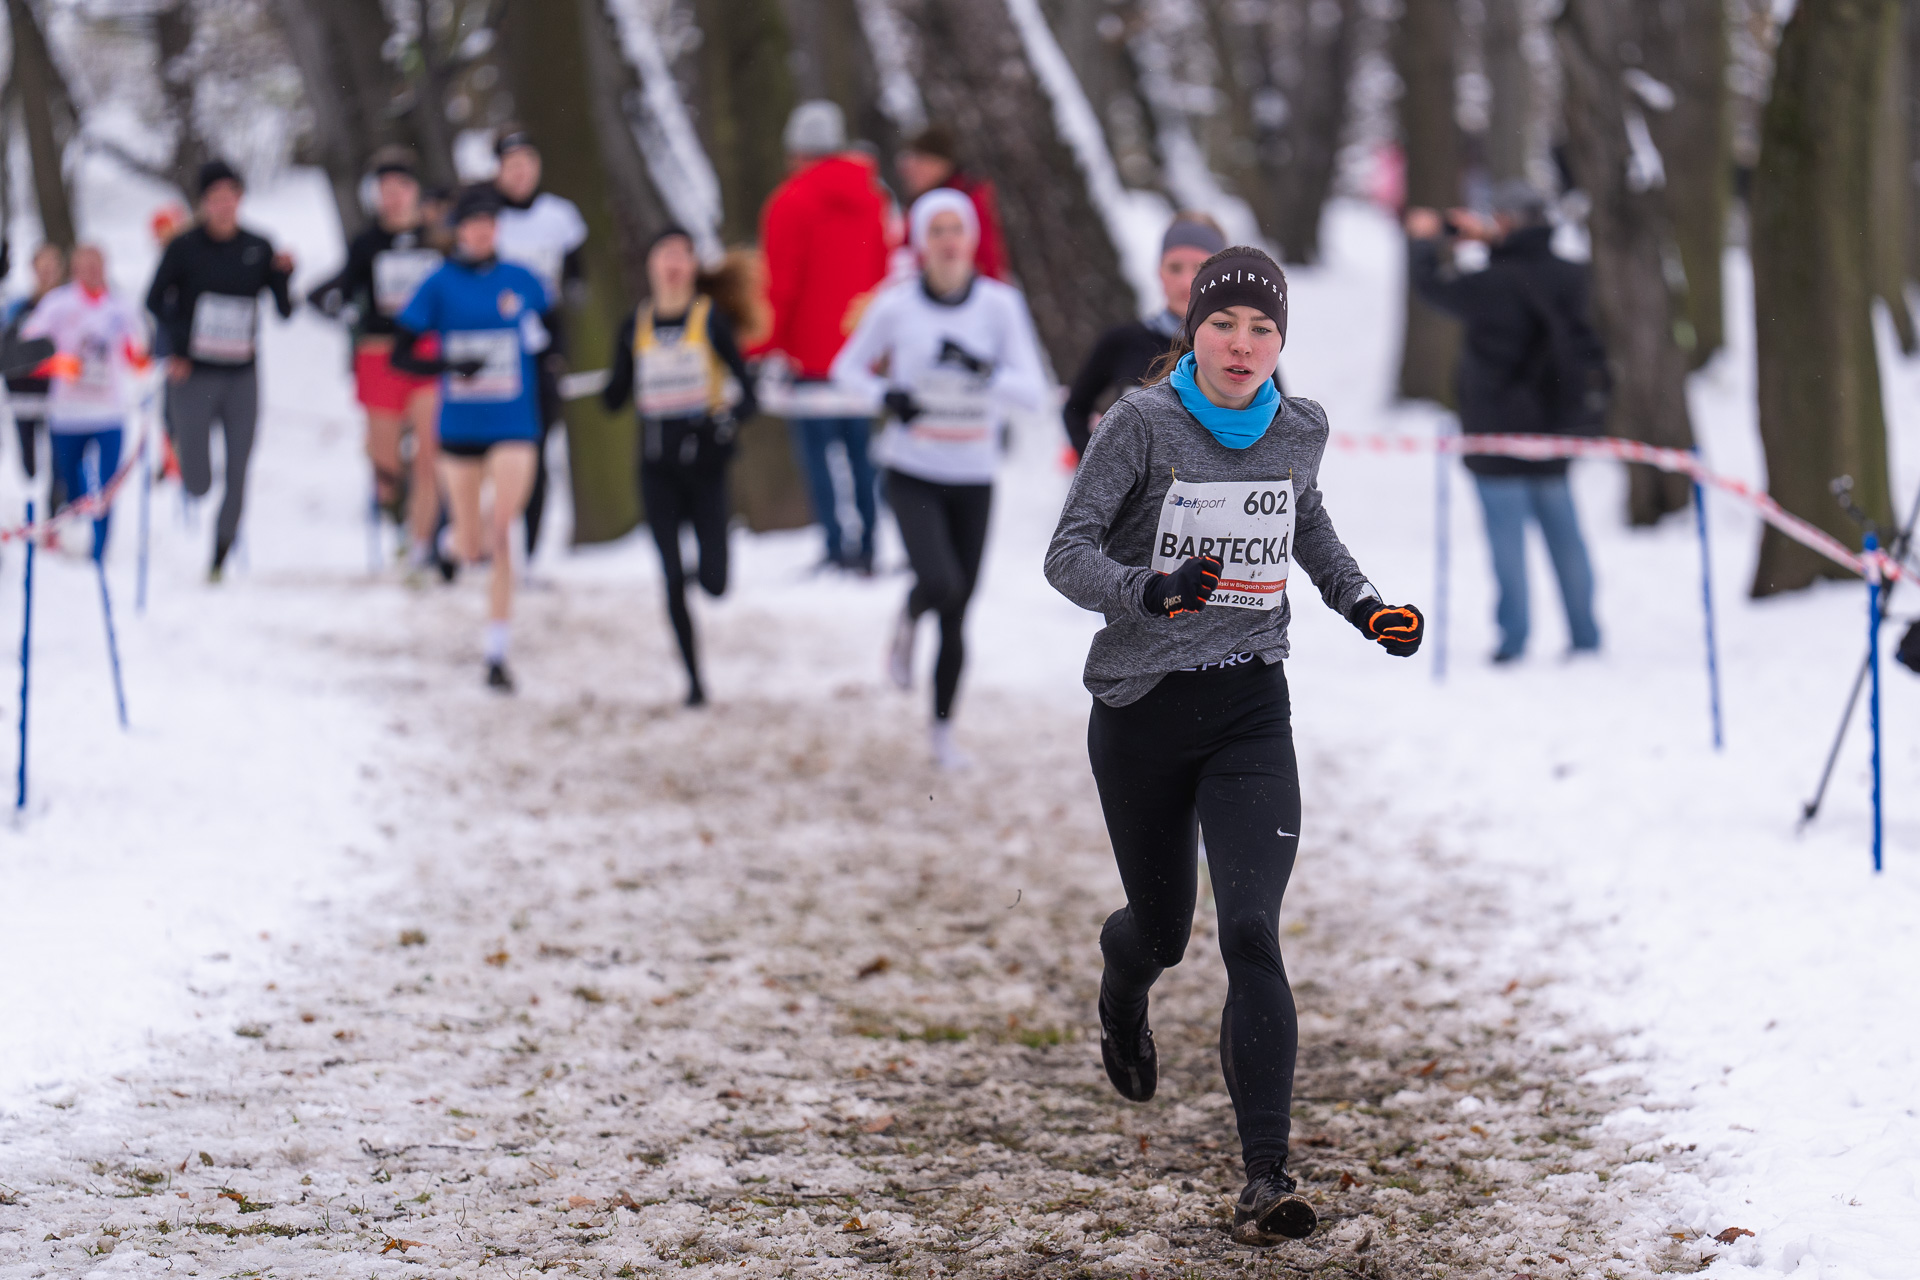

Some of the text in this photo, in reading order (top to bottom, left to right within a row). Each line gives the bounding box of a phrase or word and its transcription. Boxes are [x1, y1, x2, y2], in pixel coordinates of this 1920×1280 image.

[1243, 490, 1288, 516] 602
[1159, 532, 1288, 565] BARTECKA
[1231, 594, 1264, 608] 2024
